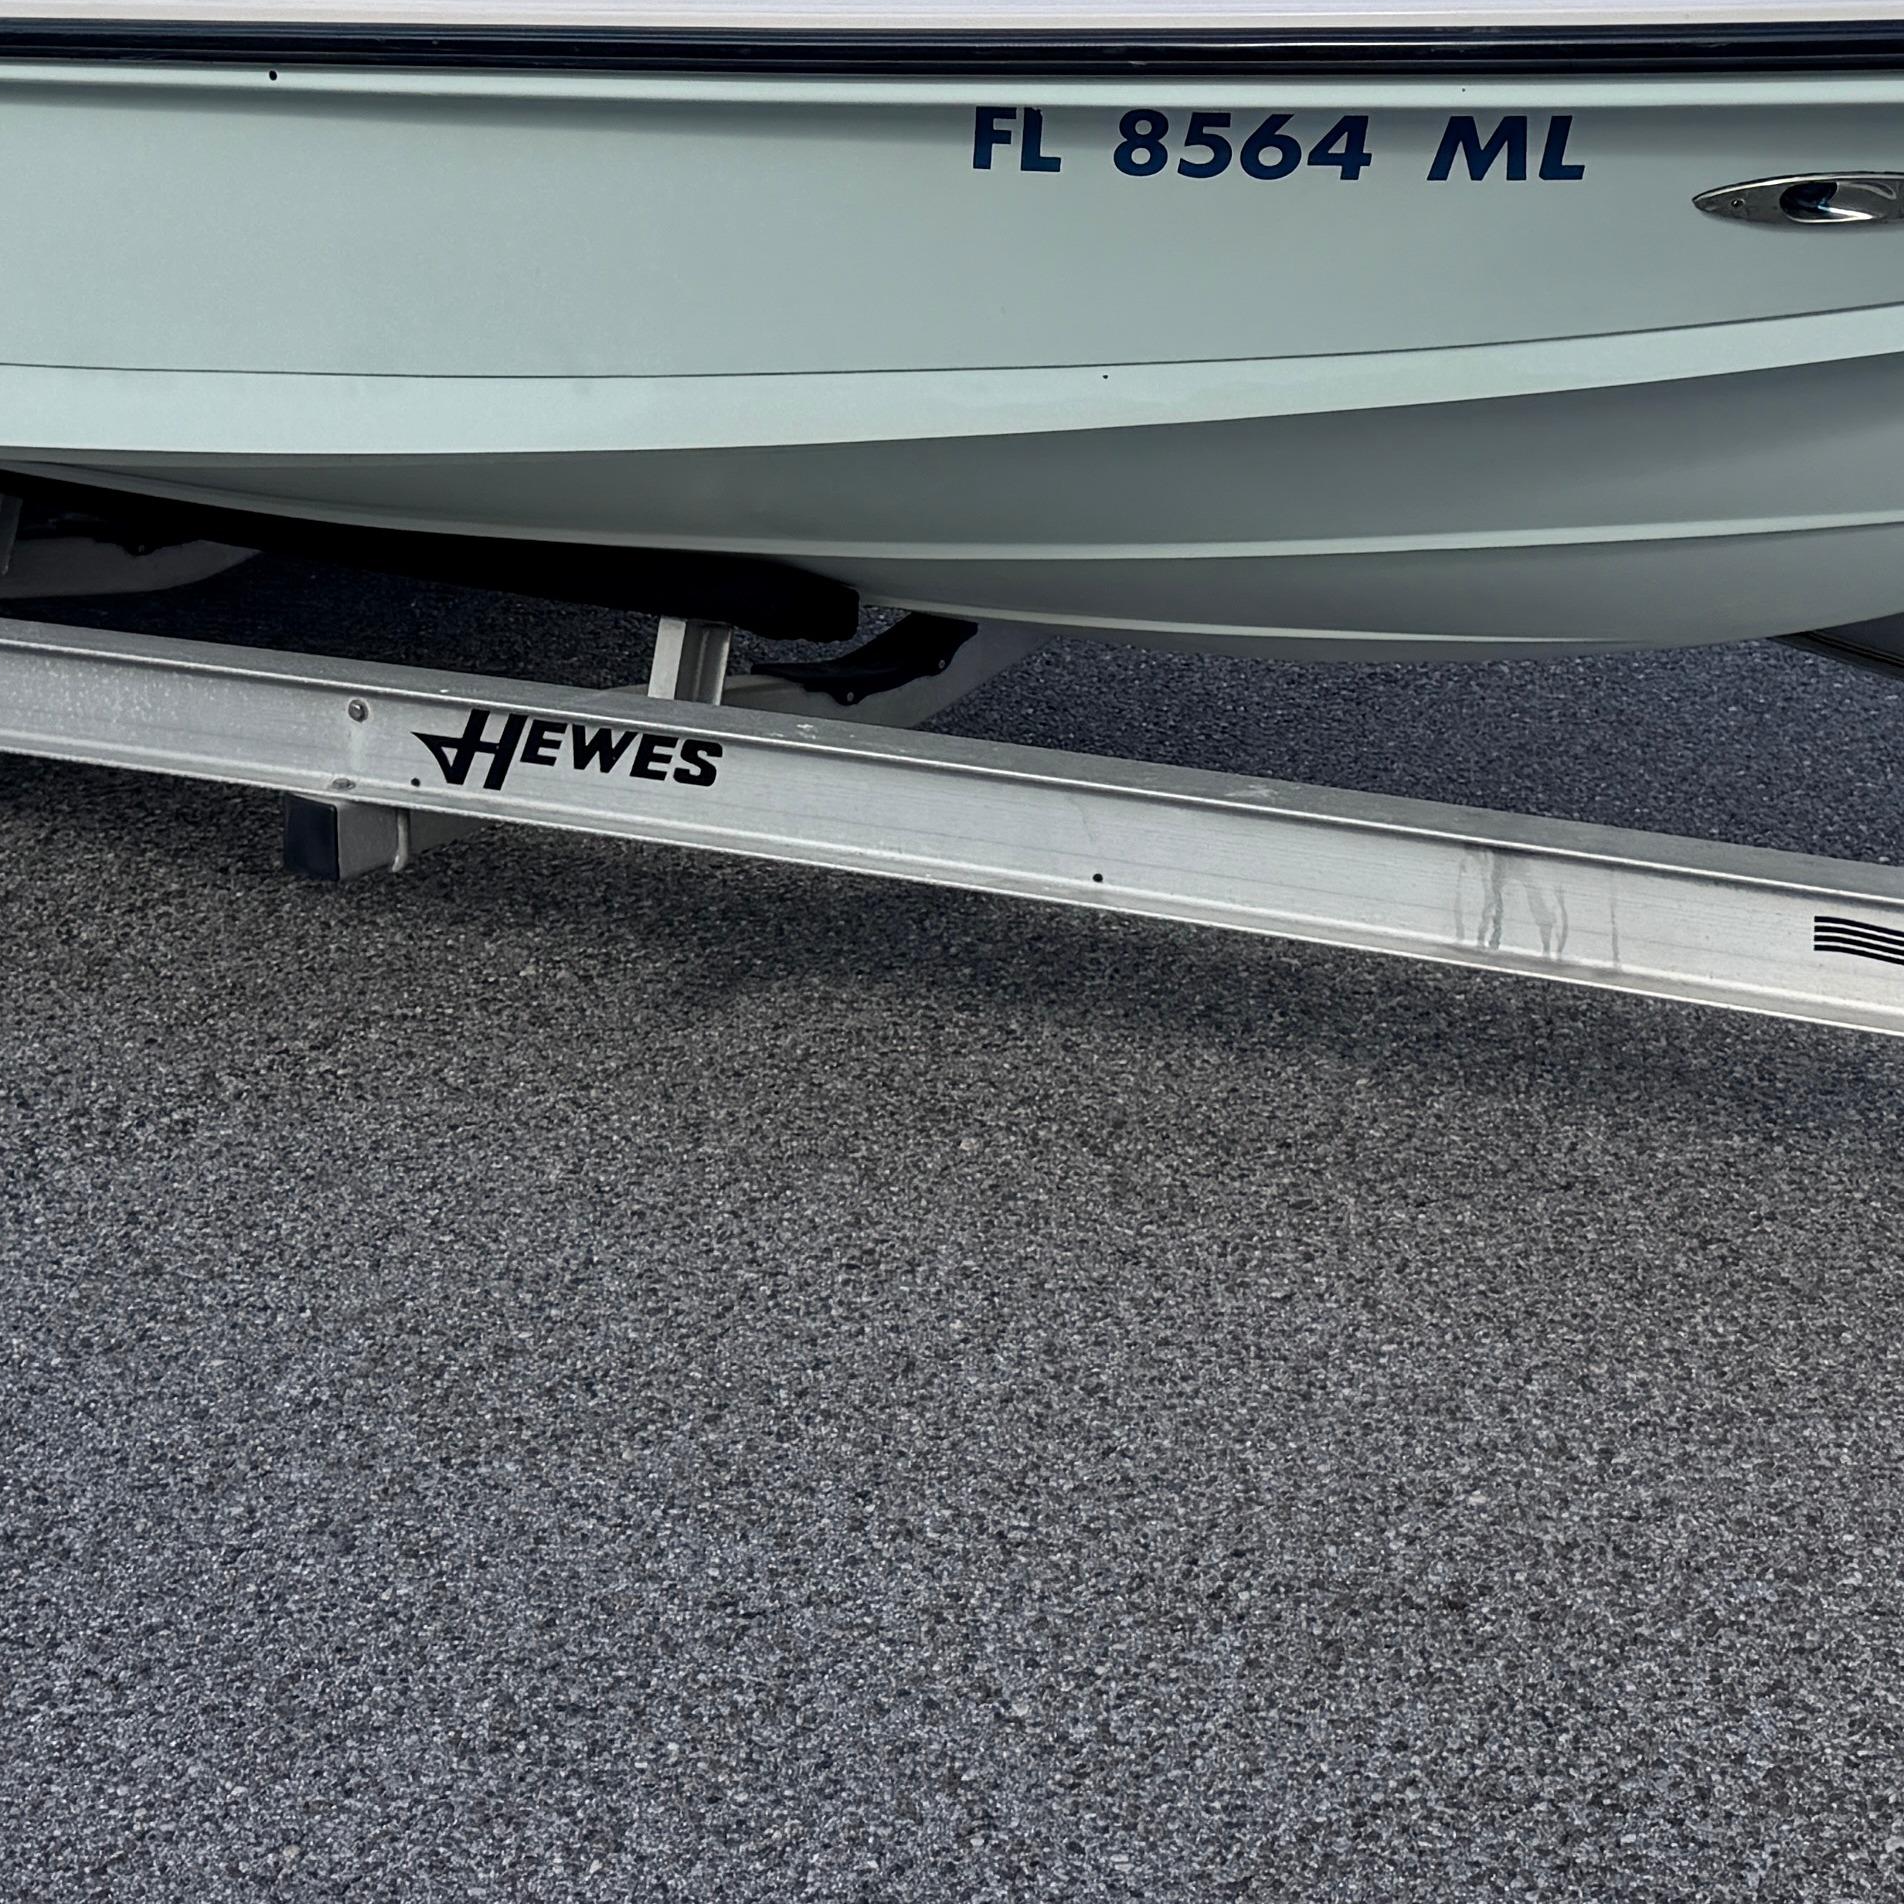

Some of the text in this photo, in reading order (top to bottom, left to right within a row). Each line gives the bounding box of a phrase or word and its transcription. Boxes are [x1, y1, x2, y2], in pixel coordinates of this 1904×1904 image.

[972, 106, 1585, 182] FL 8564 ML
[411, 708, 724, 791] HEWES
